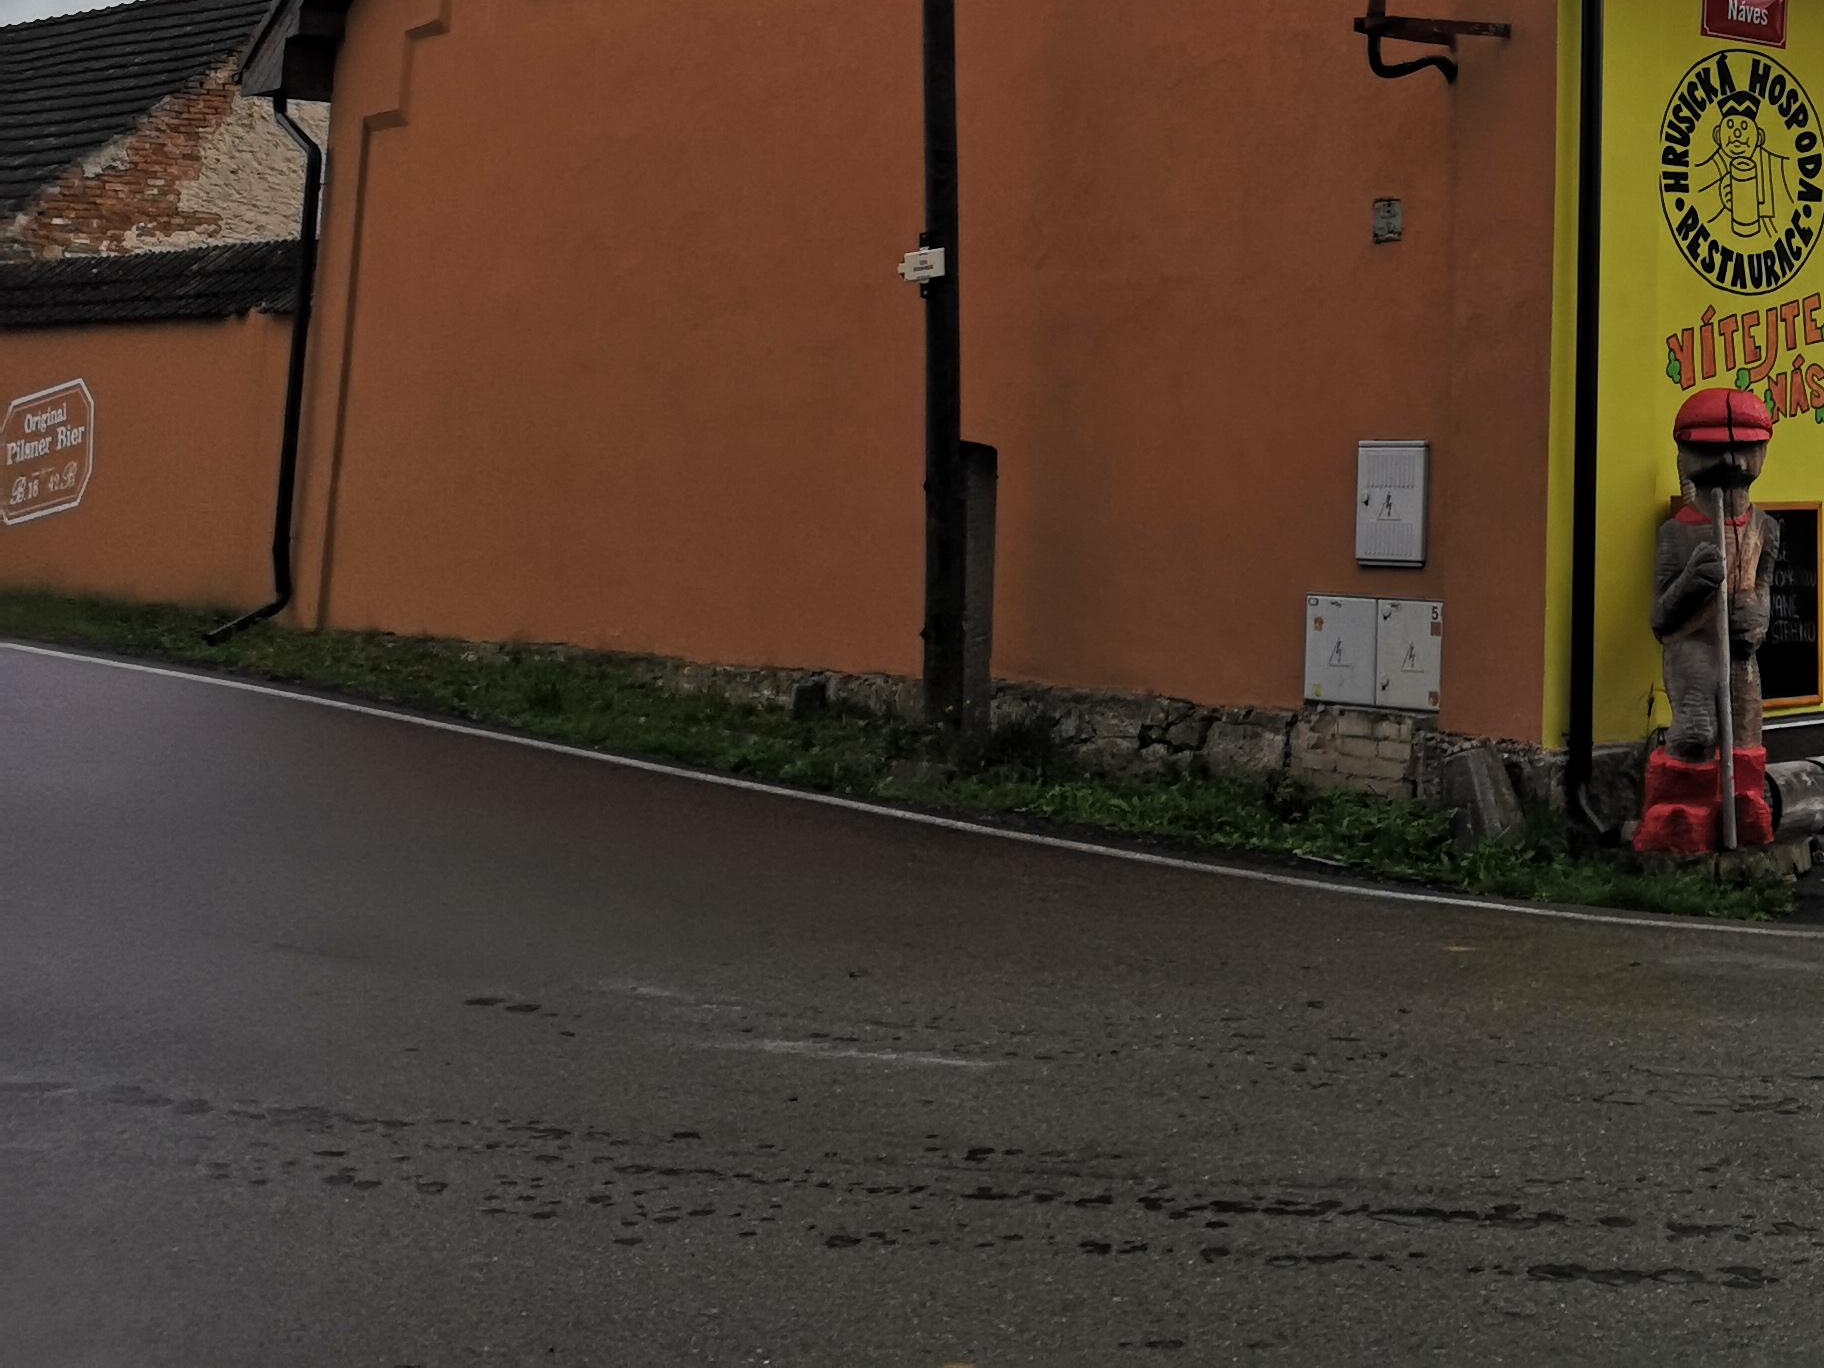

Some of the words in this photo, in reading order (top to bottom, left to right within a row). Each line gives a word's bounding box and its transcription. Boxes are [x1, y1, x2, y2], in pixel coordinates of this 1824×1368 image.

[1661, 53, 1737, 194] HRUSICKÁ
[1750, 58, 1823, 203] HOSPODA
[1675, 205, 1814, 290] RESTAURACE
[1666, 292, 1824, 390] VÍTEJTE
[6, 436, 52, 465] Pilsner
[56, 425, 85, 450] Bier
[24, 401, 67, 433] Original
[1431, 605, 1439, 620] 5
